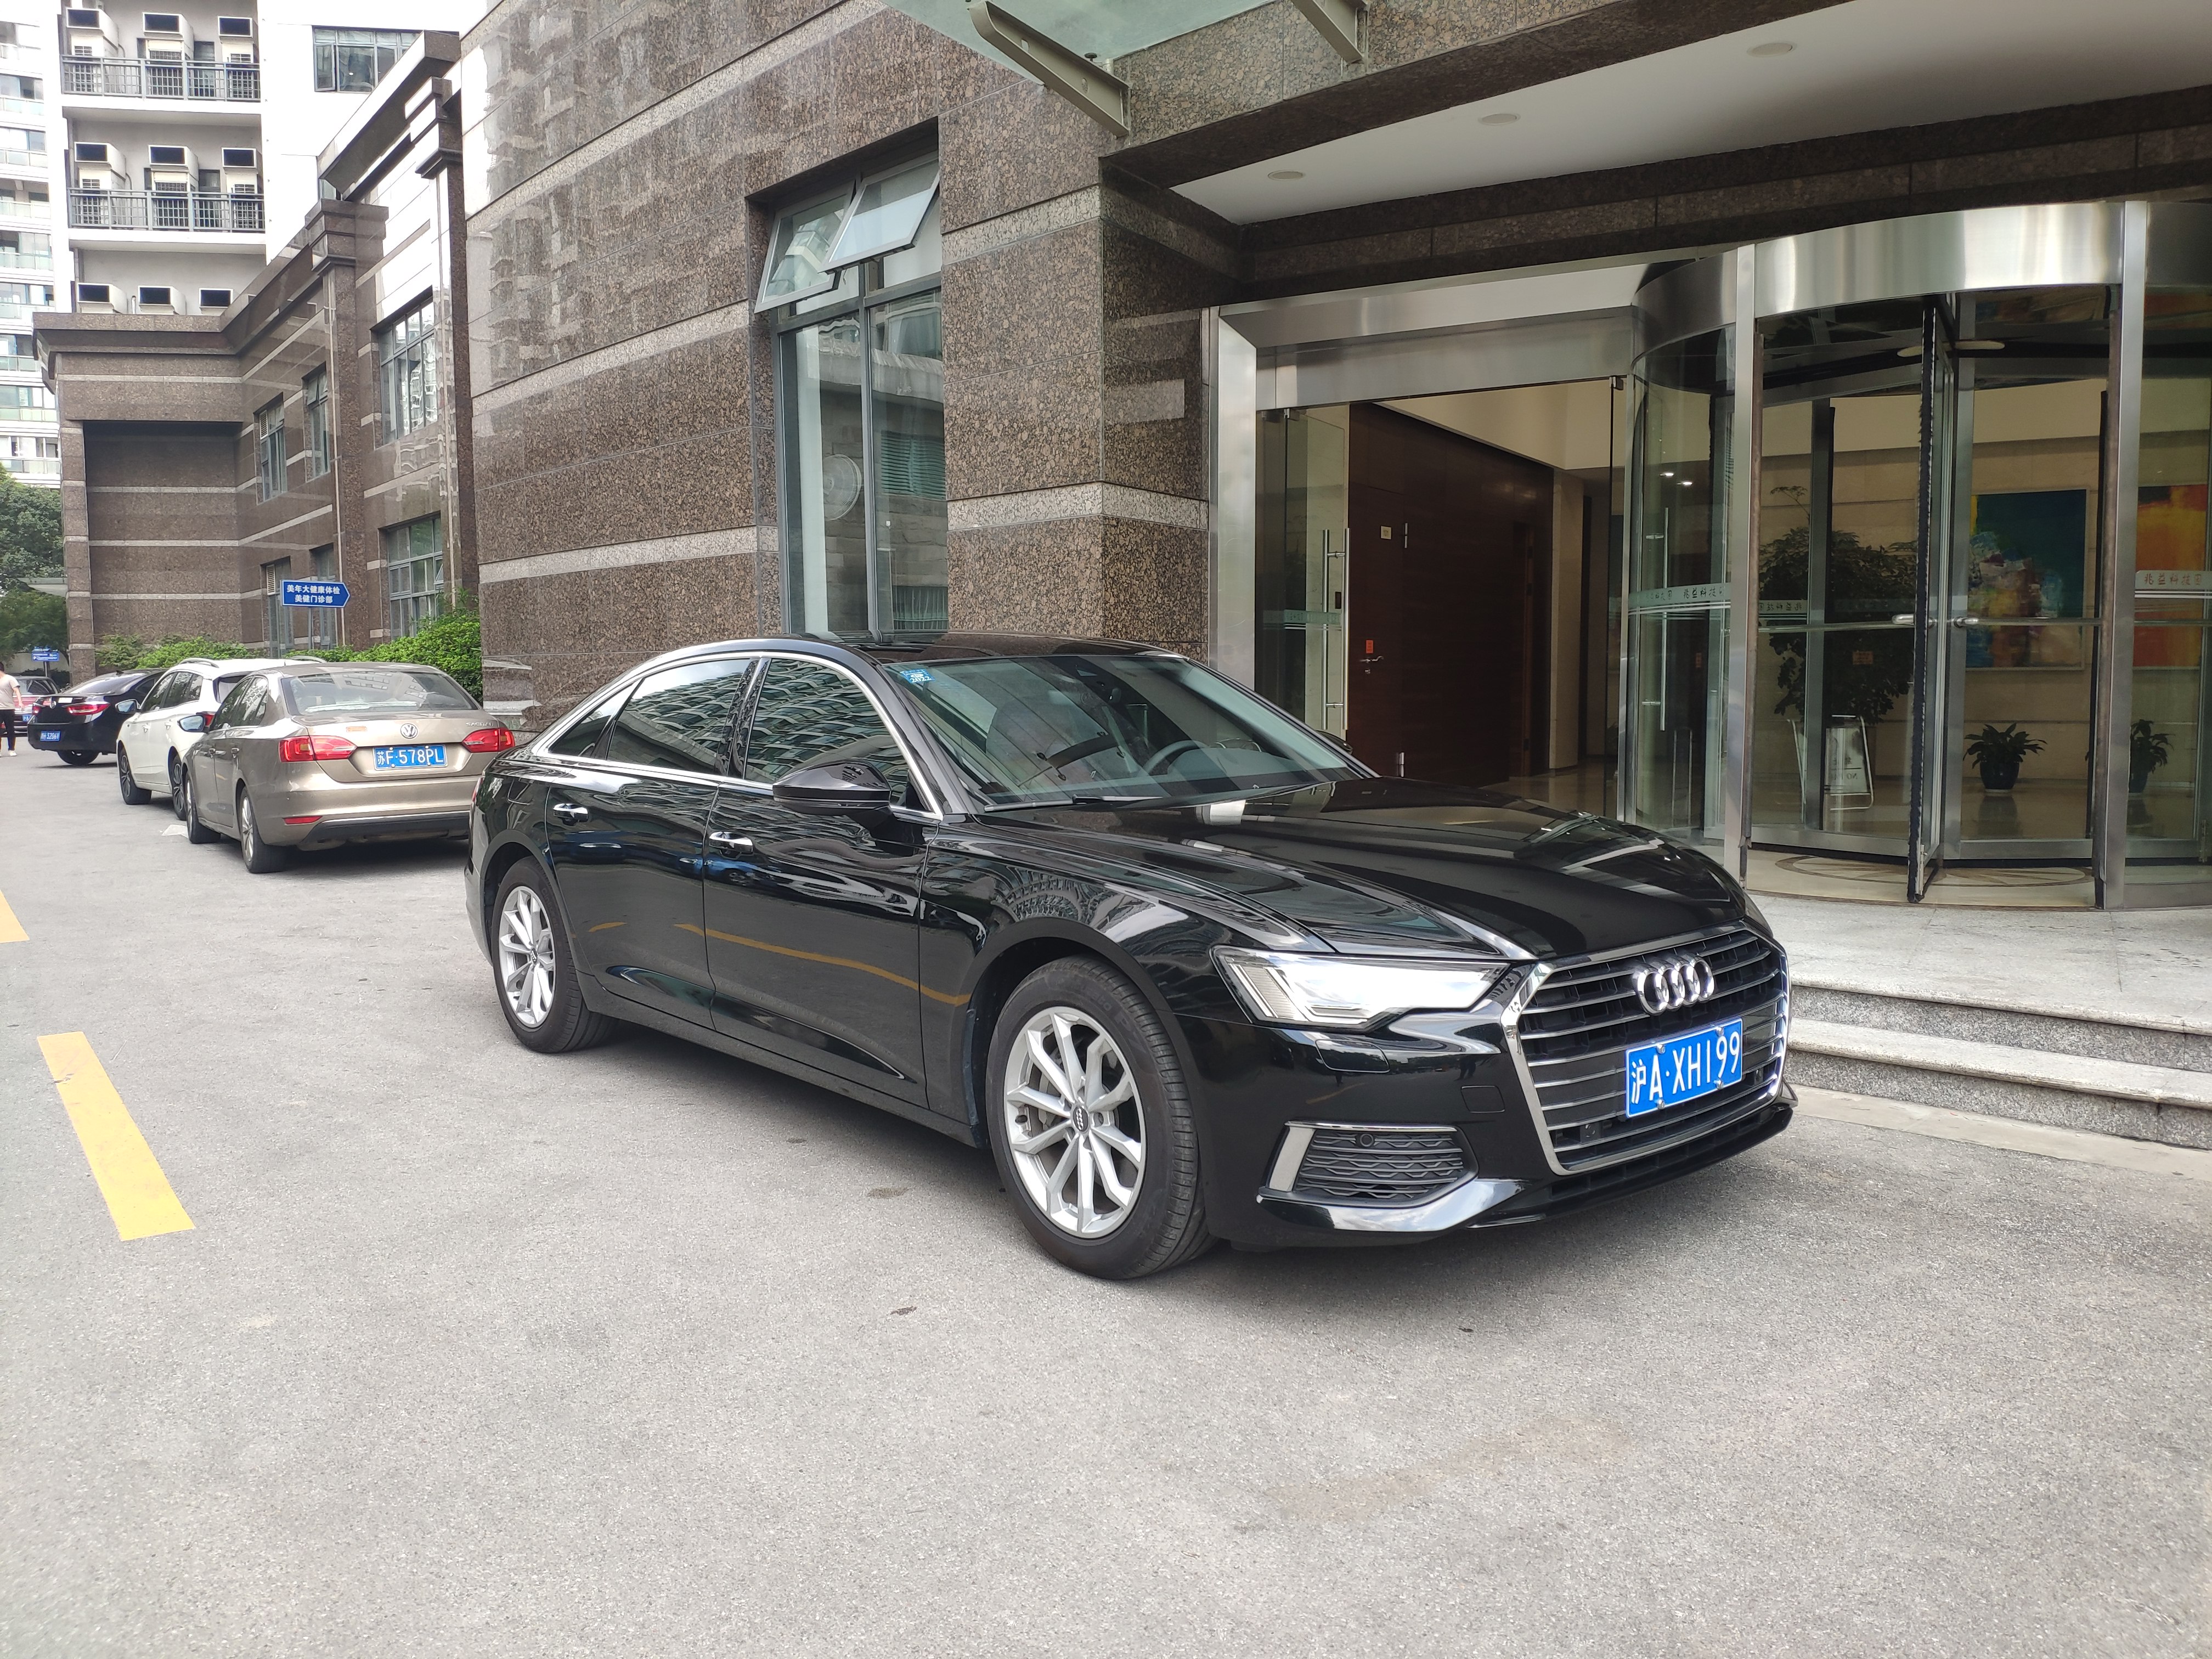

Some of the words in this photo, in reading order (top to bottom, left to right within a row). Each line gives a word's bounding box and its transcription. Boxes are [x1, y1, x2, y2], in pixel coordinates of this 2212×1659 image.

[287, 585, 340, 594] 美年大健康体检
[295, 595, 333, 603] 美健门诊部
[377, 748, 444, 765] 苏F·578PL
[1630, 1031, 1741, 1104] 沪A·XH199
